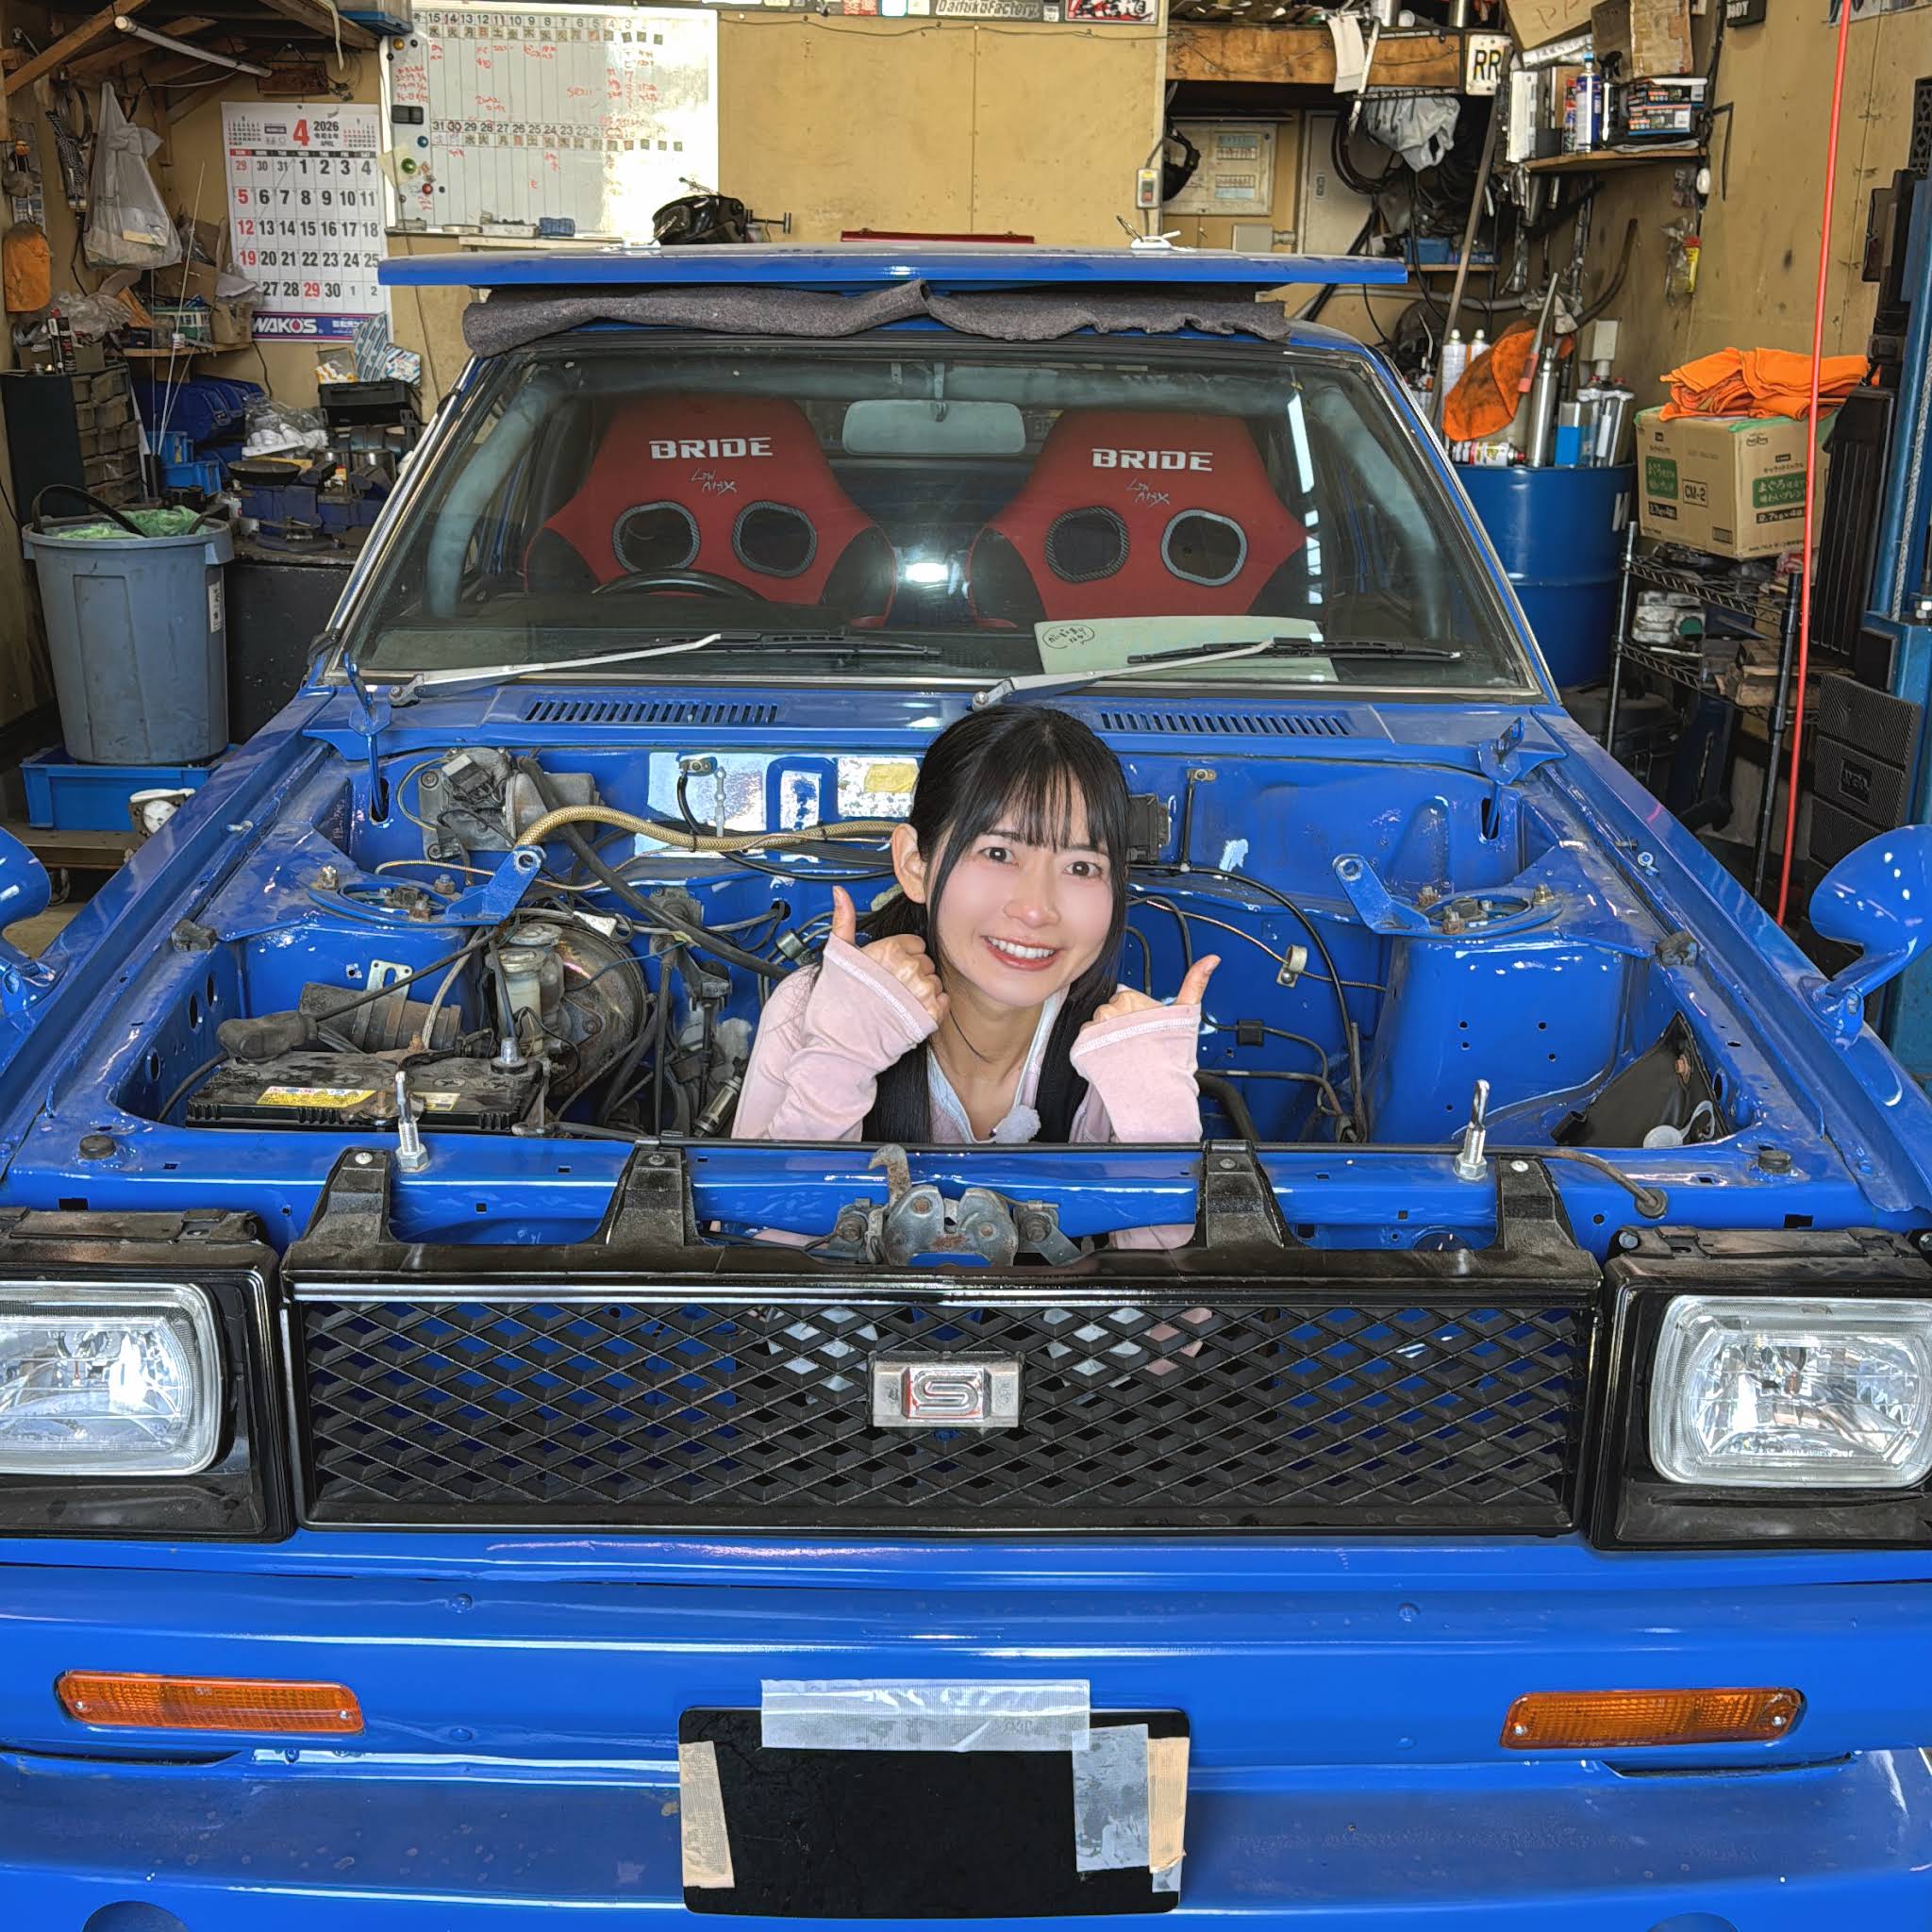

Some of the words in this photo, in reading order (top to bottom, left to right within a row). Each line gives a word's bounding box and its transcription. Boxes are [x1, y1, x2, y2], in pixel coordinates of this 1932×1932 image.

[428, 13, 441, 24] 15
[444, 13, 458, 24] 14
[461, 14, 473, 24] 13
[477, 14, 490, 25] 12
[509, 16, 522, 25] 10
[527, 16, 535, 25] 9
[543, 17, 552, 26] 8
[560, 18, 568, 26] 7
[576, 18, 584, 27] 6
[1474, 49, 1502, 81] RR
[292, 119, 310, 147] 4
[313, 121, 340, 132] 2026
[433, 121, 444, 131] 31
[447, 120, 462, 132] 30
[464, 122, 477, 132] 29
[480, 122, 493, 133] 28
[497, 124, 509, 133] 27
[512, 124, 525, 134] 26
[528, 124, 541, 134] 25
[544, 125, 557, 134] 24
[559, 125, 574, 135] 23
[575, 126, 590, 137] 22
[236, 160, 247, 171] 29
[257, 160, 268, 172] 30
[277, 160, 288, 172] 31
[299, 159, 308, 175] 1
[320, 159, 330, 175] 2
[341, 159, 351, 175] 3
[361, 160, 372, 175] 4
[238, 189, 249, 205] 5
[258, 189, 270, 205] 6
[279, 190, 290, 205] 7
[301, 191, 311, 206] 8
[322, 191, 332, 206] 9
[340, 191, 356, 206] 10
[360, 191, 375, 207] 11
[238, 220, 255, 235] 12
[258, 220, 275, 235] 13
[279, 220, 295, 236] 14
[300, 221, 316, 236] 15
[321, 221, 337, 236] 16
[341, 222, 358, 237] 17
[362, 222, 378, 237] 18
[240, 250, 257, 266] 19
[260, 251, 277, 266] 20
[281, 251, 296, 266] 21
[302, 252, 318, 267] 22
[323, 252, 339, 267] 23
[342, 253, 359, 268] 24
[364, 253, 379, 268] 25
[263, 281, 278, 296] 27
[283, 281, 299, 297] 28
[304, 282, 321, 297] 29
[325, 282, 341, 298] 30
[350, 286, 356, 296] 1
[370, 286, 378, 296] 2
[648, 437, 774, 459] BRIDE
[1091, 448, 1213, 472] BRIDE
[1684, 484, 1707, 502] CM-2
